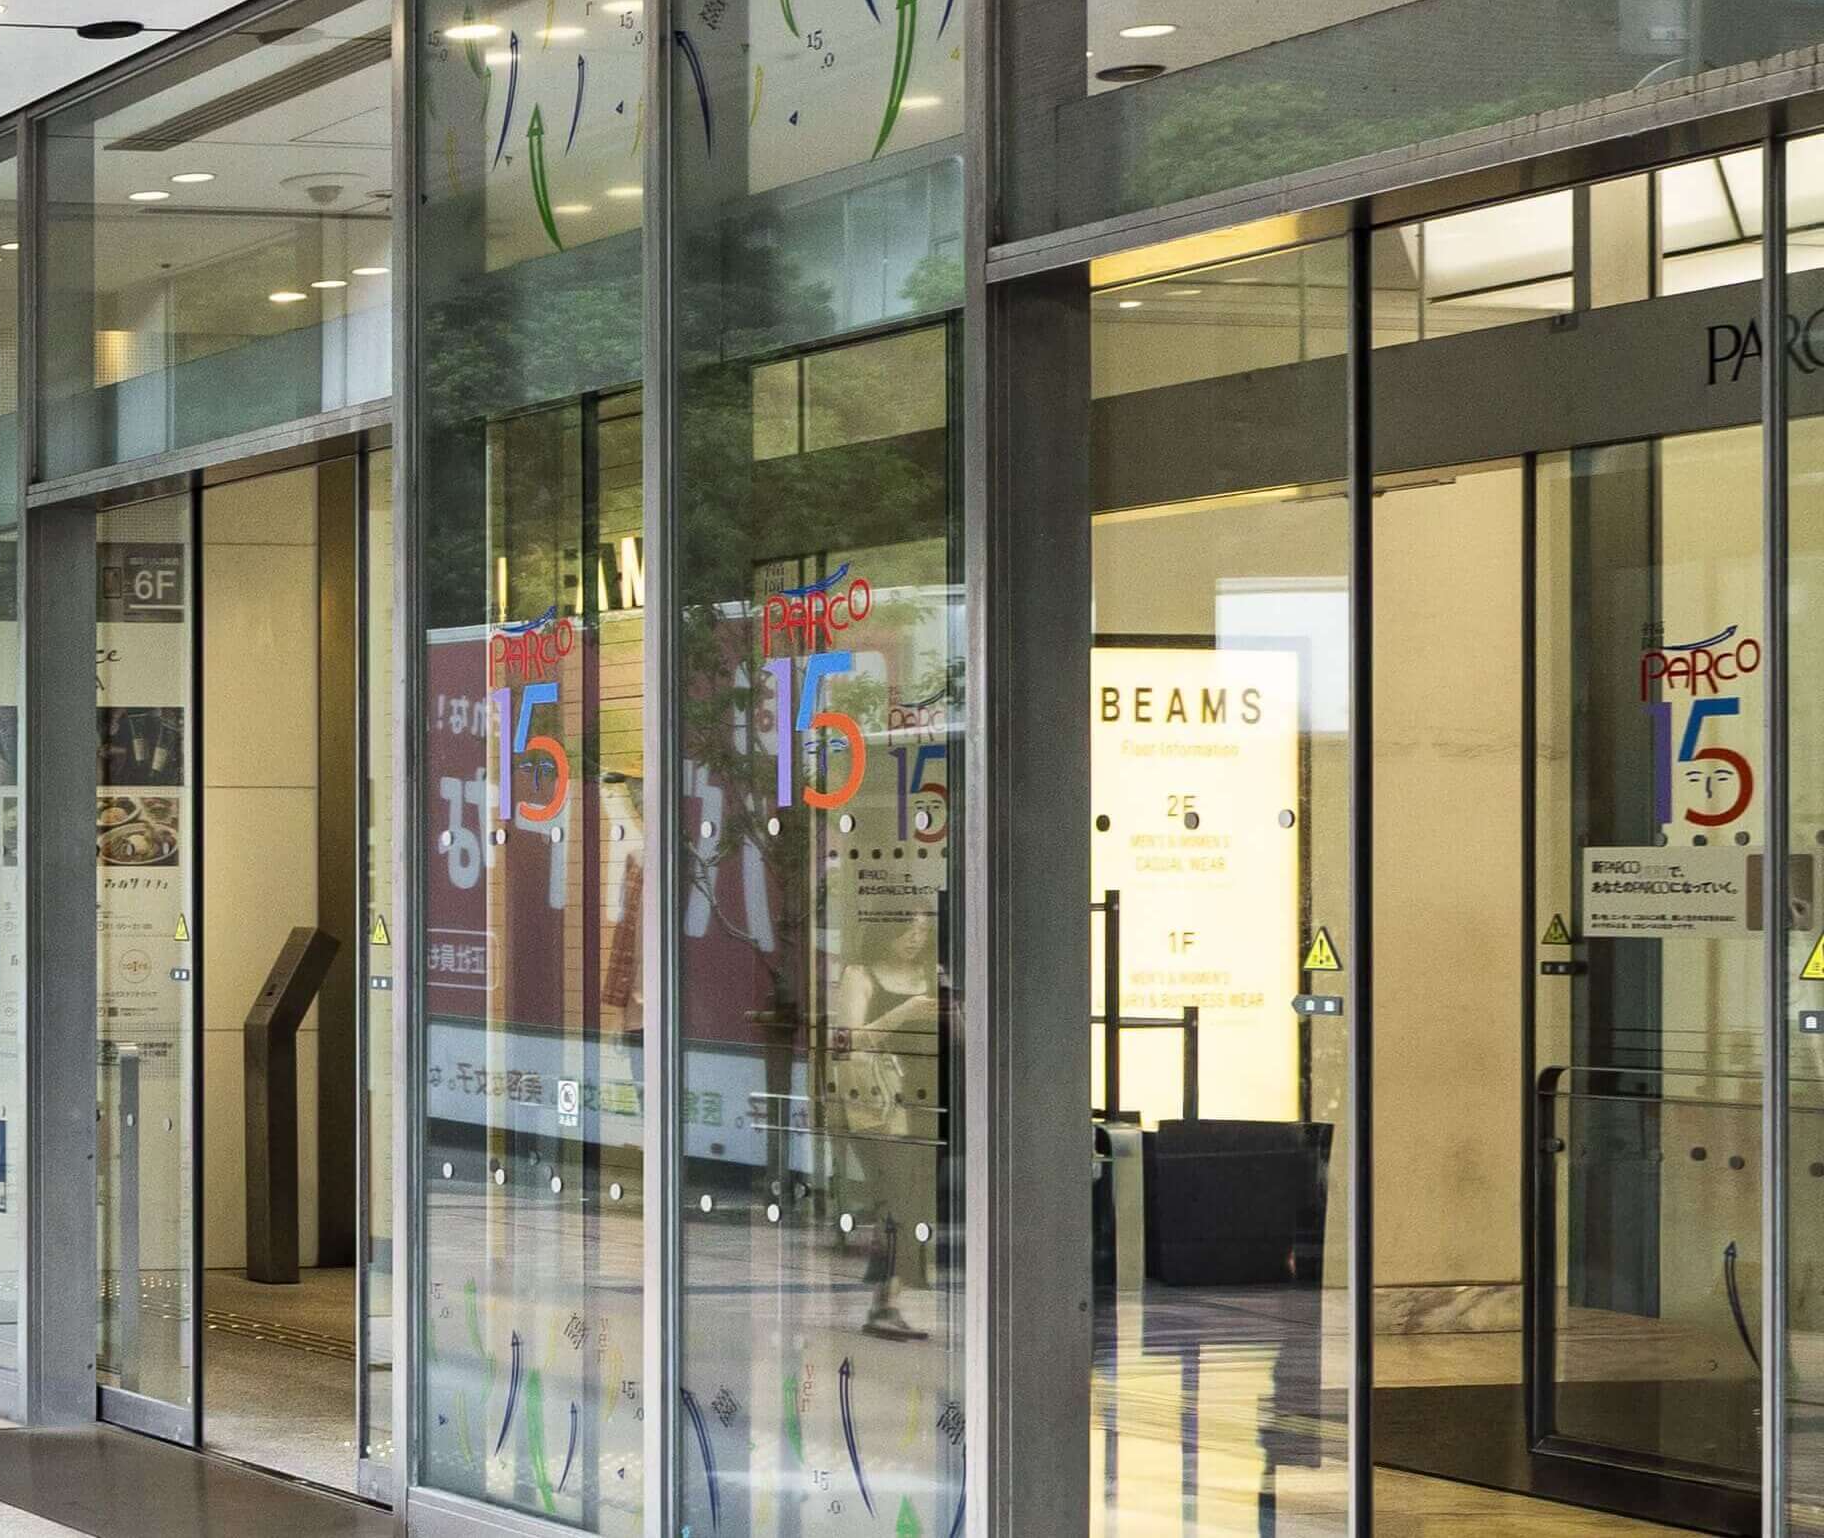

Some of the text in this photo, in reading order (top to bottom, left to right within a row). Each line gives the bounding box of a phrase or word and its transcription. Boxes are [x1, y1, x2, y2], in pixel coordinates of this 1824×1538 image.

[619, 11, 635, 29] 15
[807, 29, 823, 50] 15
[136, 570, 177, 600] 6F
[762, 579, 871, 658] PARCO
[489, 618, 573, 687] PARCO
[1640, 638, 1761, 702] PARCO
[1101, 687, 1262, 724] BEAMS
[761, 650, 866, 810] 15
[887, 707, 946, 747] PARC
[492, 682, 570, 822] 15
[1642, 697, 1754, 827] 15
[1167, 795, 1197, 817] 2F
[1168, 931, 1196, 954] 1F
